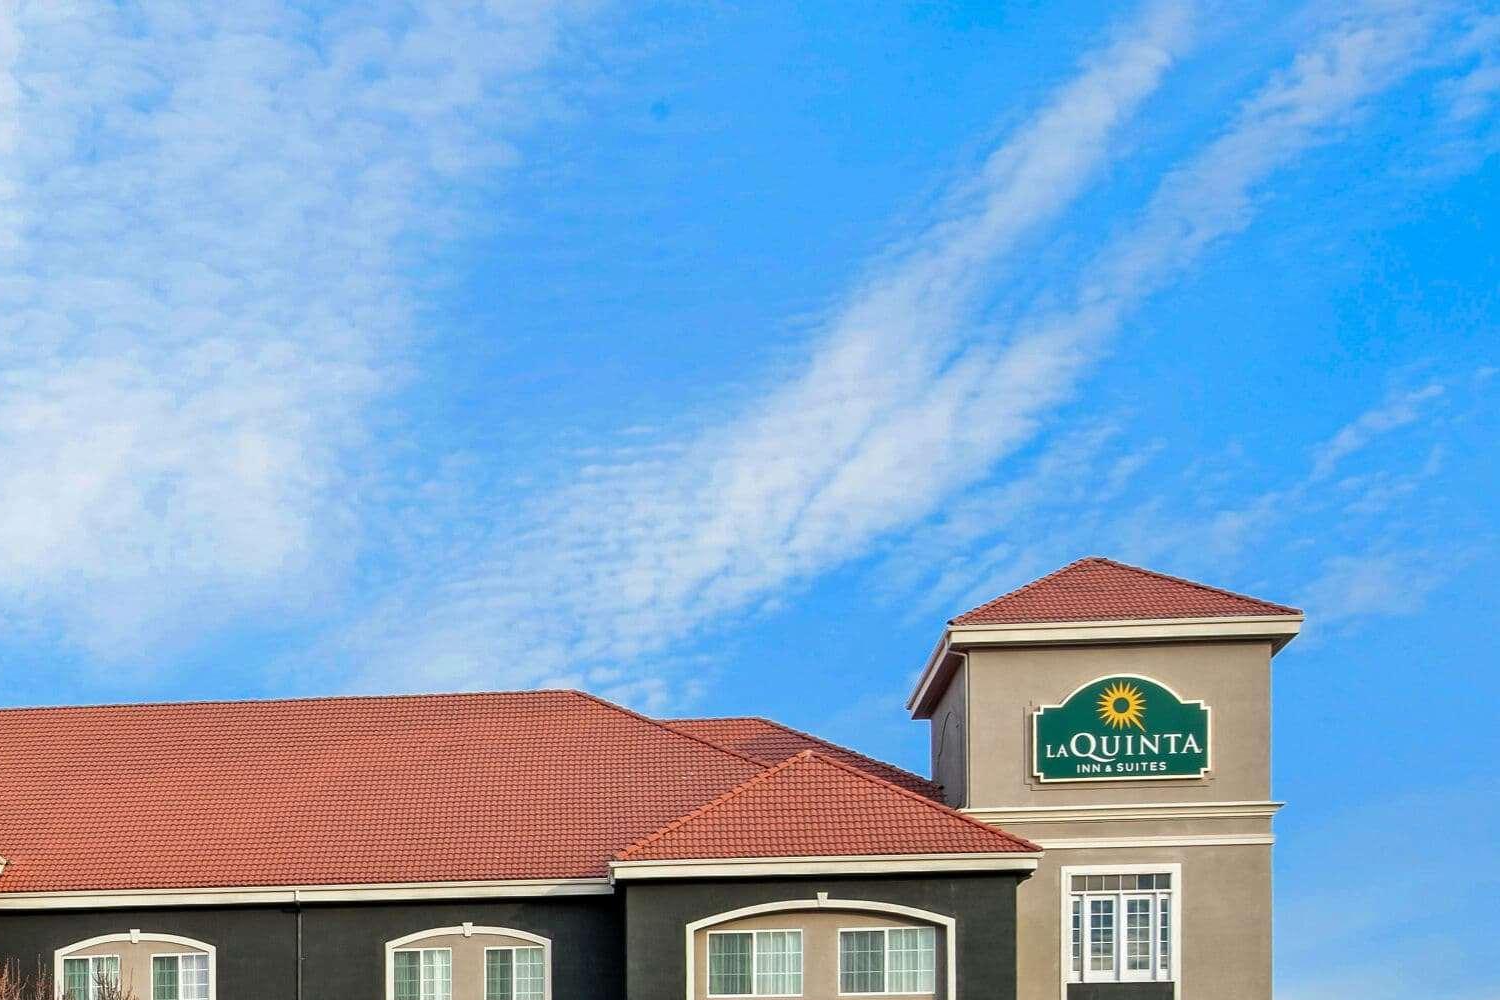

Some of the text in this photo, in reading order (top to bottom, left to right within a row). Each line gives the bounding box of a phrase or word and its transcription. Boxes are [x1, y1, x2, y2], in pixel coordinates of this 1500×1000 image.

[1046, 732, 1203, 762] LA QUINTA
[1077, 764, 1100, 773] INN
[1116, 762, 1167, 772] SUITES
